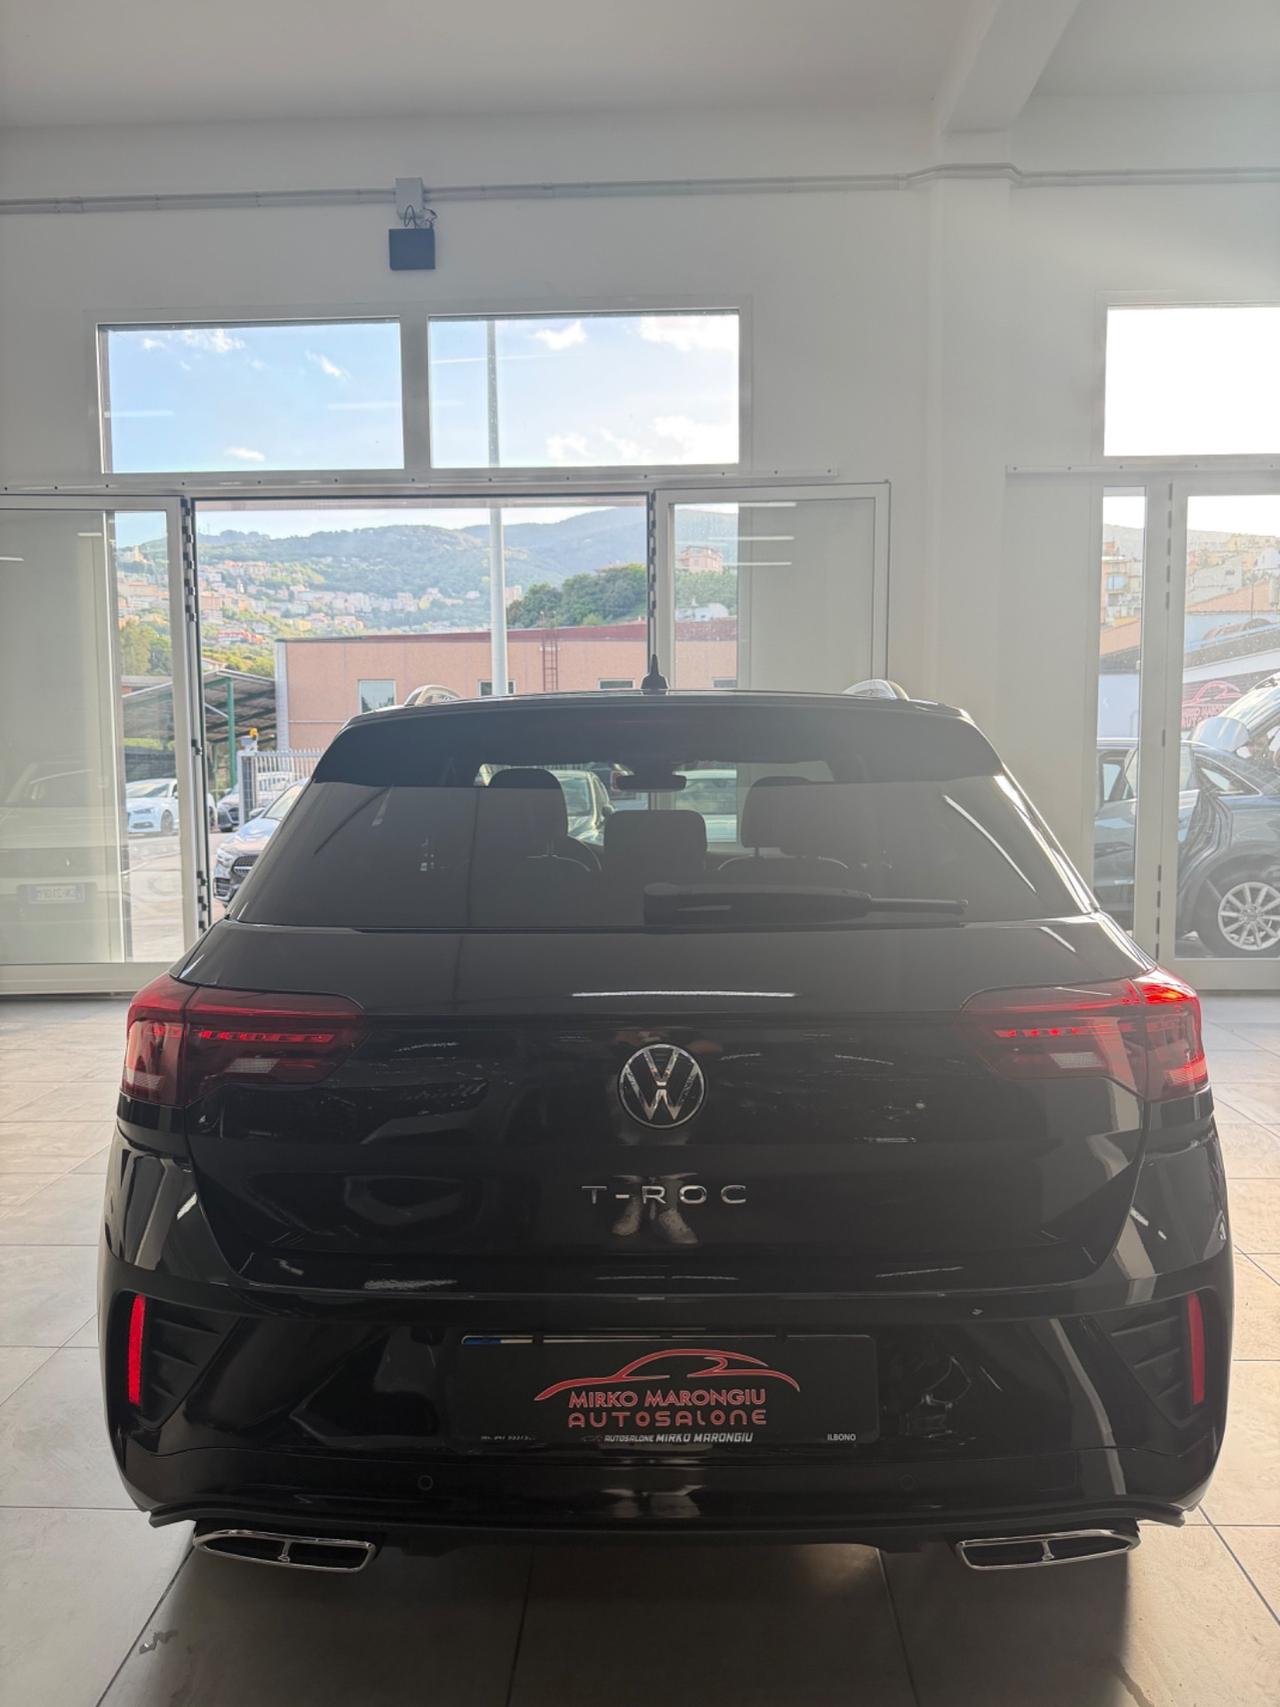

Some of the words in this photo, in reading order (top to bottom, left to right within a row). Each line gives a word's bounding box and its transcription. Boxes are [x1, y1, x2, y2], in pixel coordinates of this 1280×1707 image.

[581, 1184, 747, 1205] T-ROC
[568, 1390, 639, 1409] MIRKO
[644, 1388, 767, 1407] MARONGIU
[568, 1409, 767, 1429] AUTOSALONE
[604, 1434, 654, 1443] AUTOSALONE
[655, 1433, 691, 1443] MIRKO
[693, 1432, 753, 1443] MARONGIU
[827, 1433, 857, 1441] ILBONO
